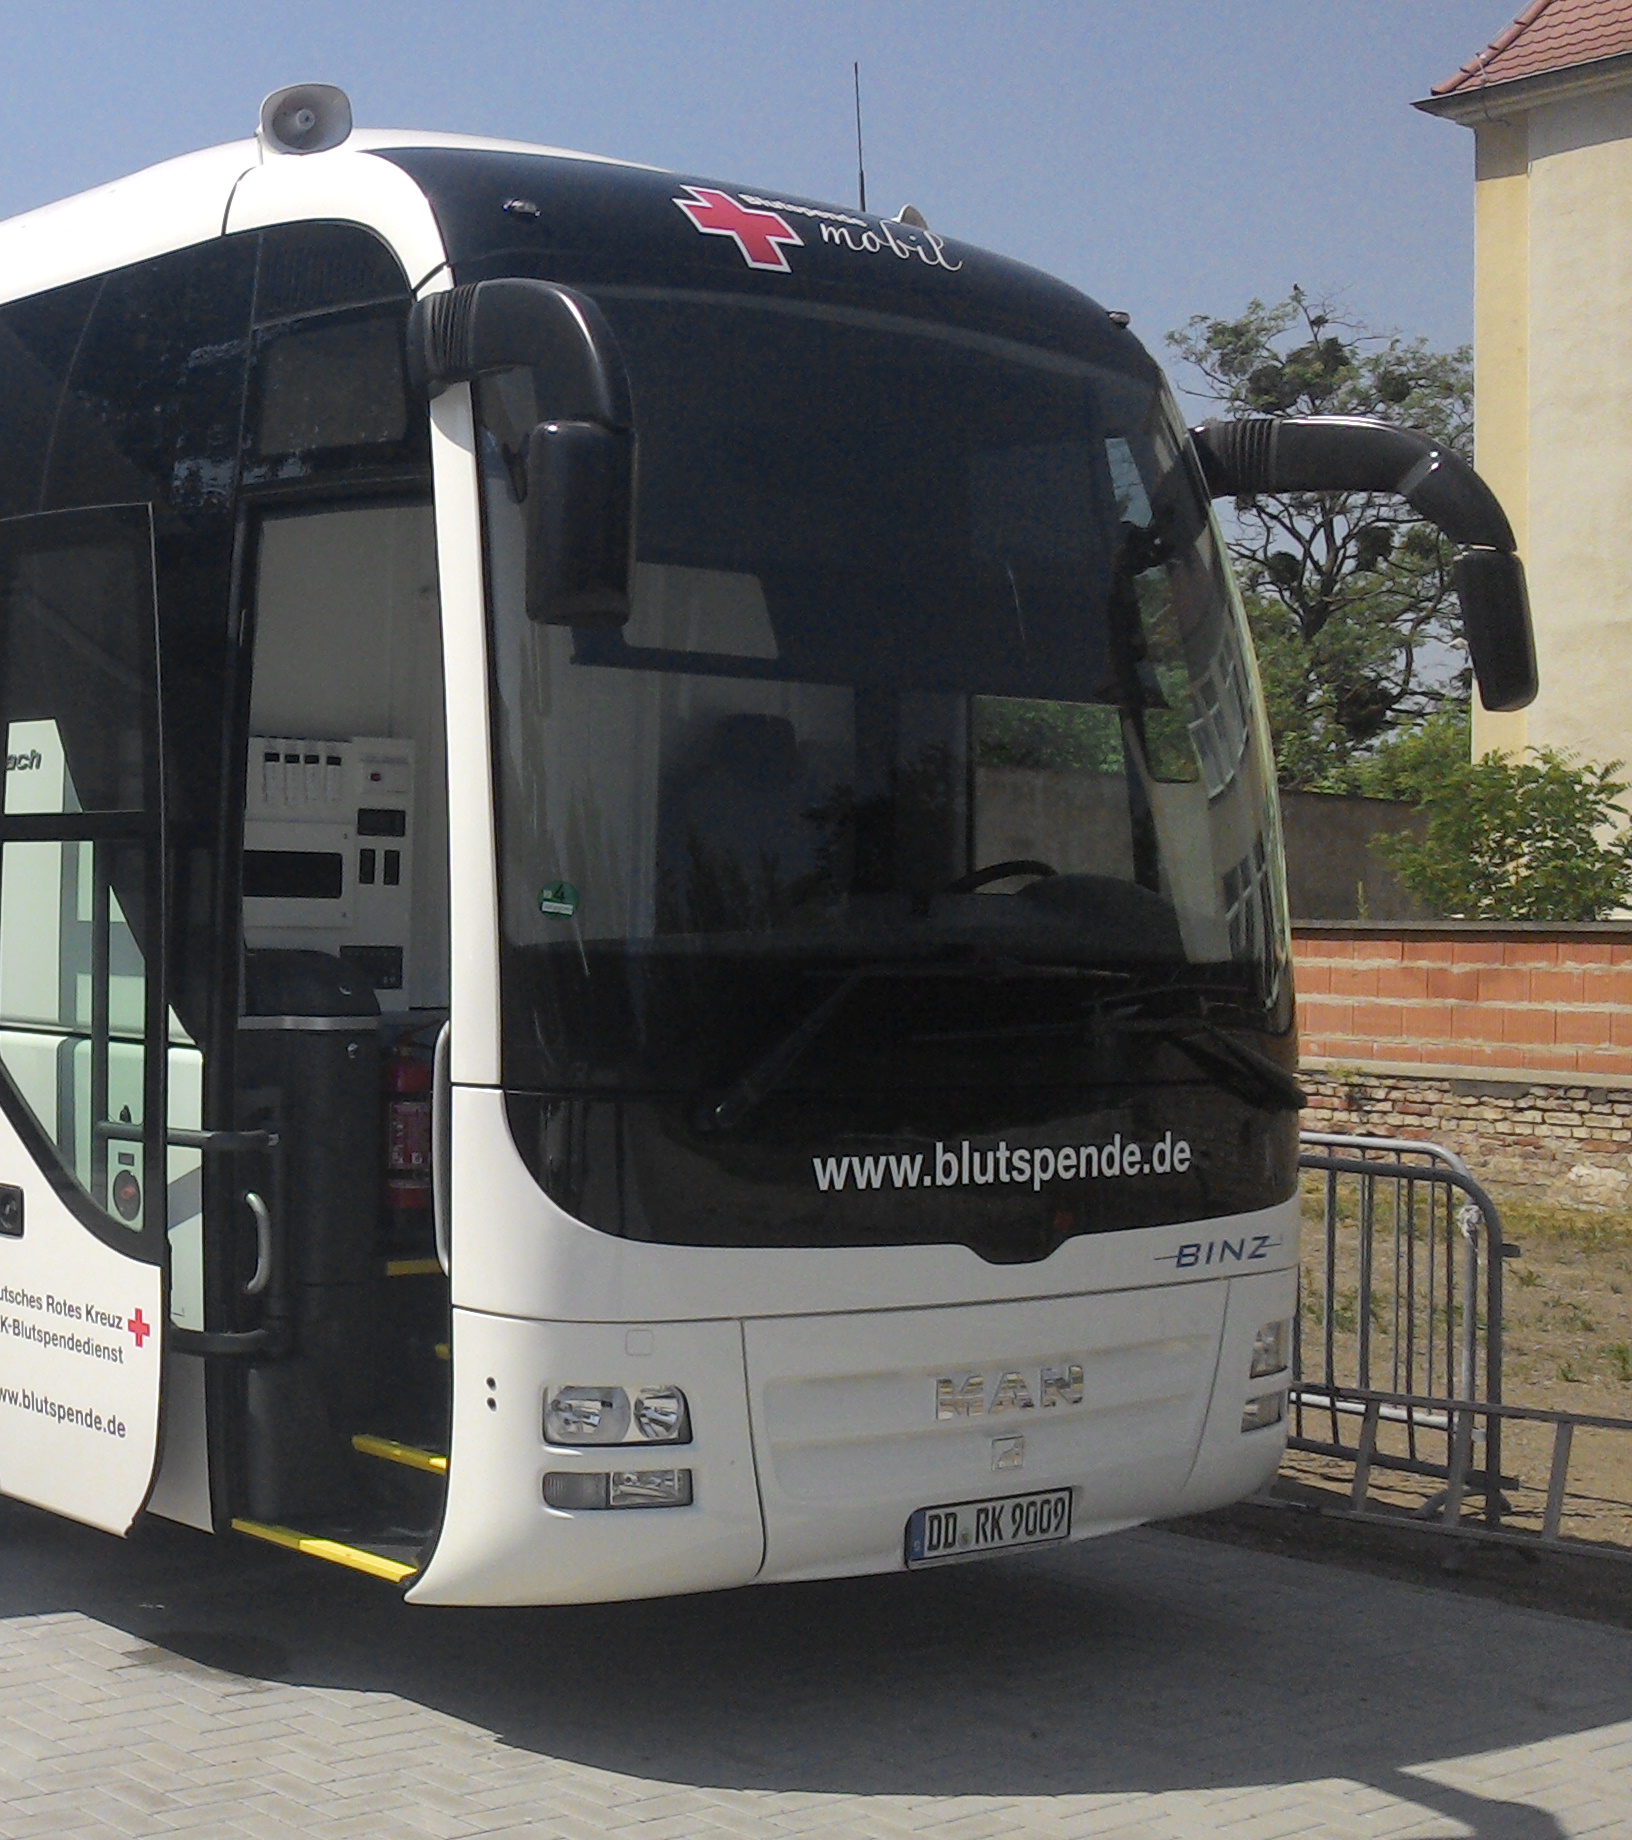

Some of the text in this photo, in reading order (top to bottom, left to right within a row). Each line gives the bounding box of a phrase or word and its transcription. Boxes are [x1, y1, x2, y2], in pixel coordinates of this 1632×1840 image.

[819, 219, 963, 271] mobil
[5, 748, 42, 771] ach
[812, 1131, 1192, 1191] www.blutspende.de
[1175, 1235, 1271, 1268] BINZ
[46, 1294, 82, 1320] Rotes
[85, 1303, 123, 1331] Kreuz
[935, 1365, 1085, 1421] MAN
[927, 1512, 958, 1551] DD
[975, 1504, 1005, 1545] RK
[1011, 1497, 1066, 1539] 9009
